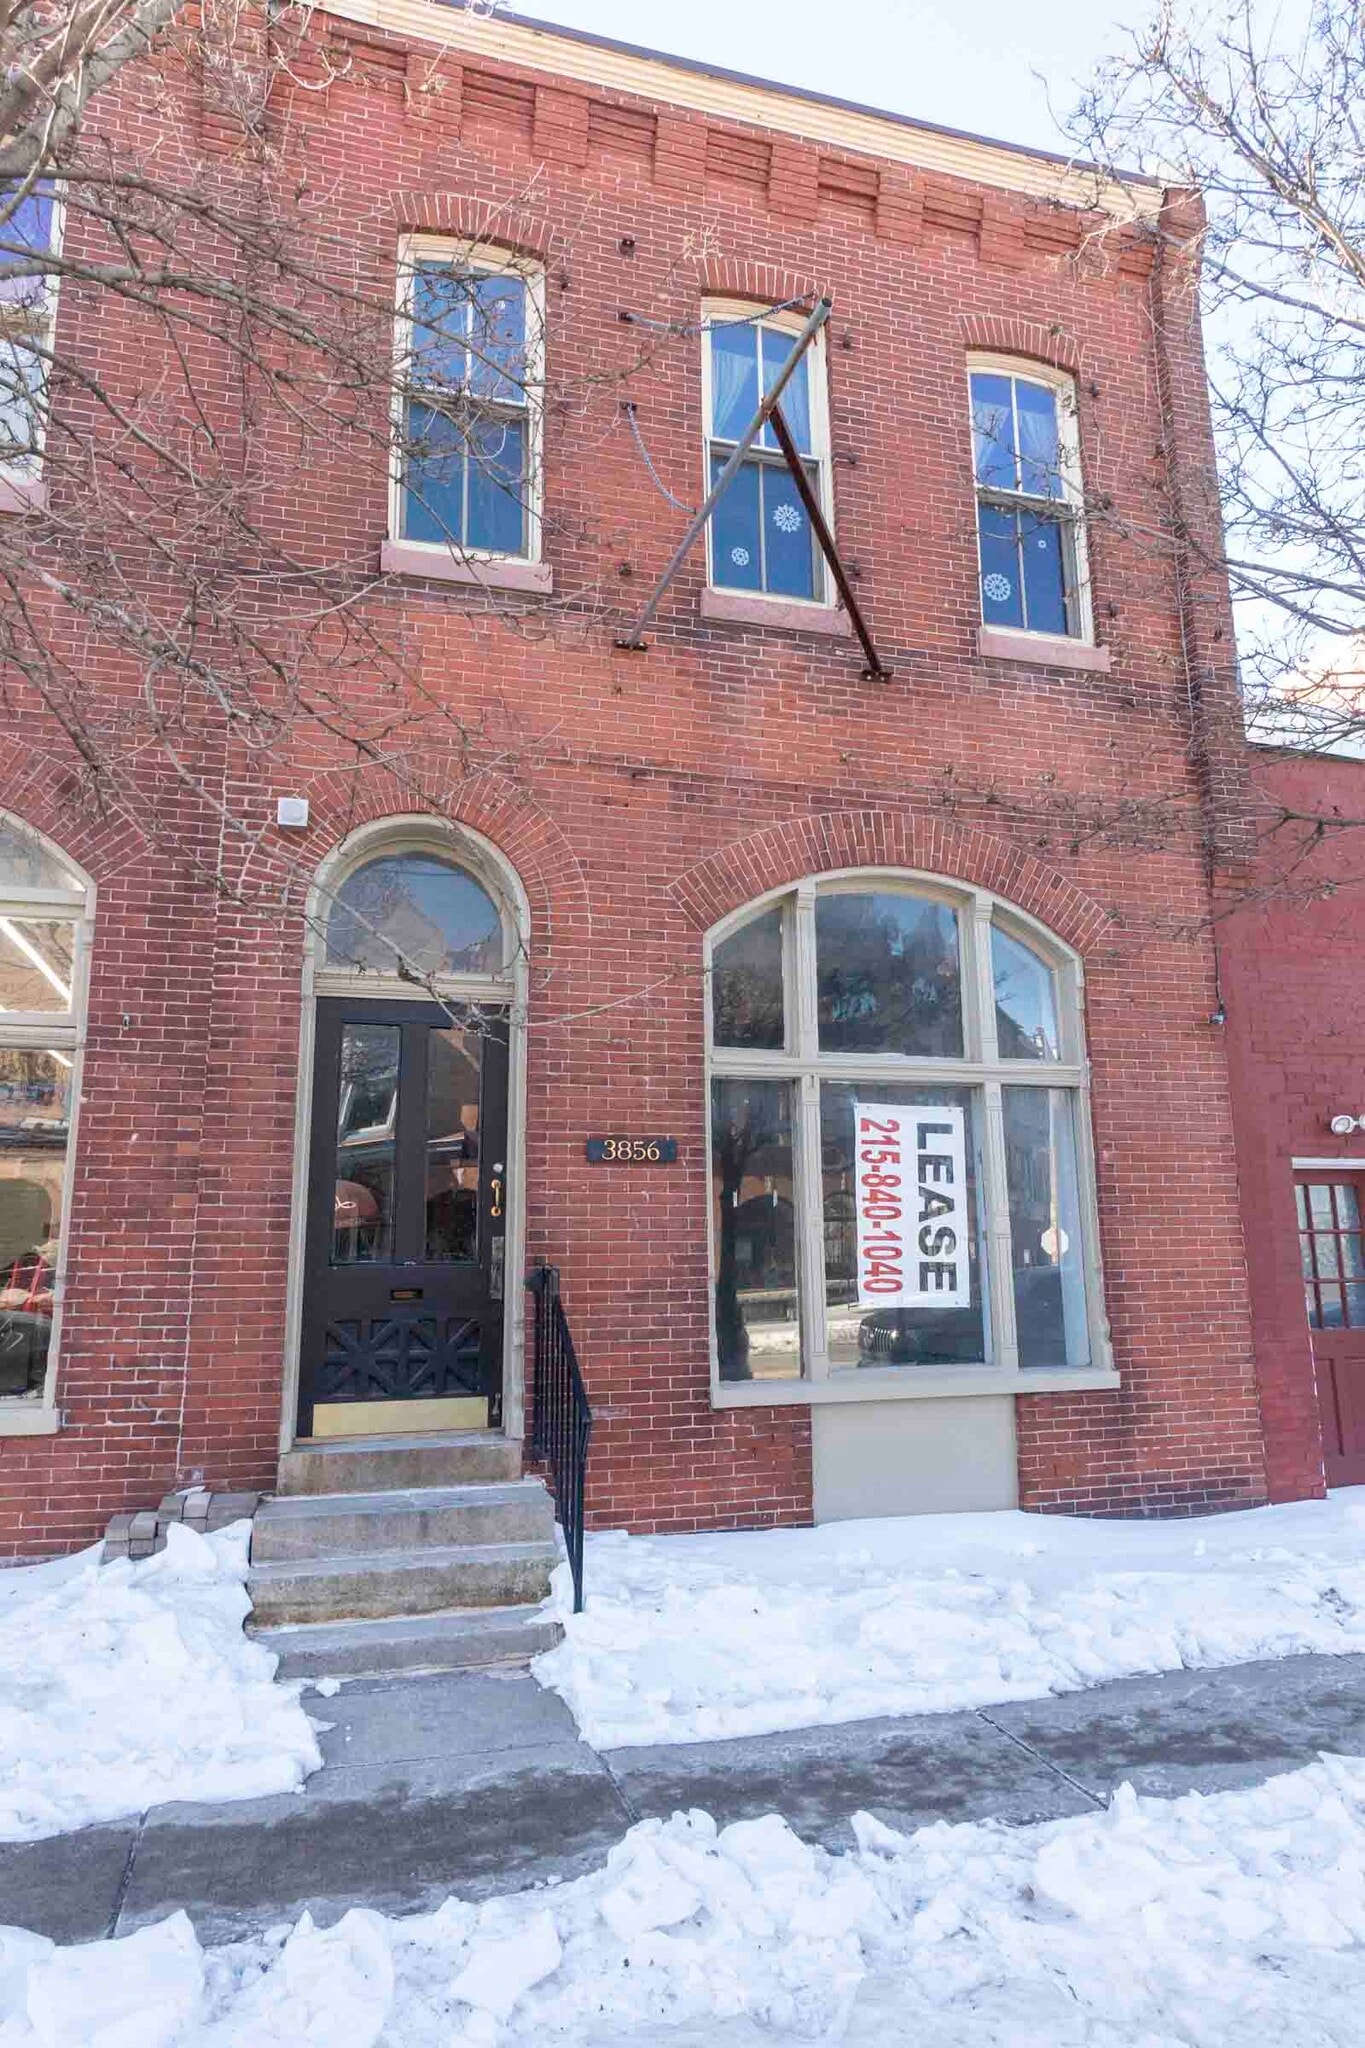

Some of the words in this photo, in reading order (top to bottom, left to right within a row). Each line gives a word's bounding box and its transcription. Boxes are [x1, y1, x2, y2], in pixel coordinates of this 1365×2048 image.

[601, 1139, 660, 1160] 3856
[860, 1117, 903, 1293] 215-840-1040
[917, 1123, 958, 1292] LEASE
